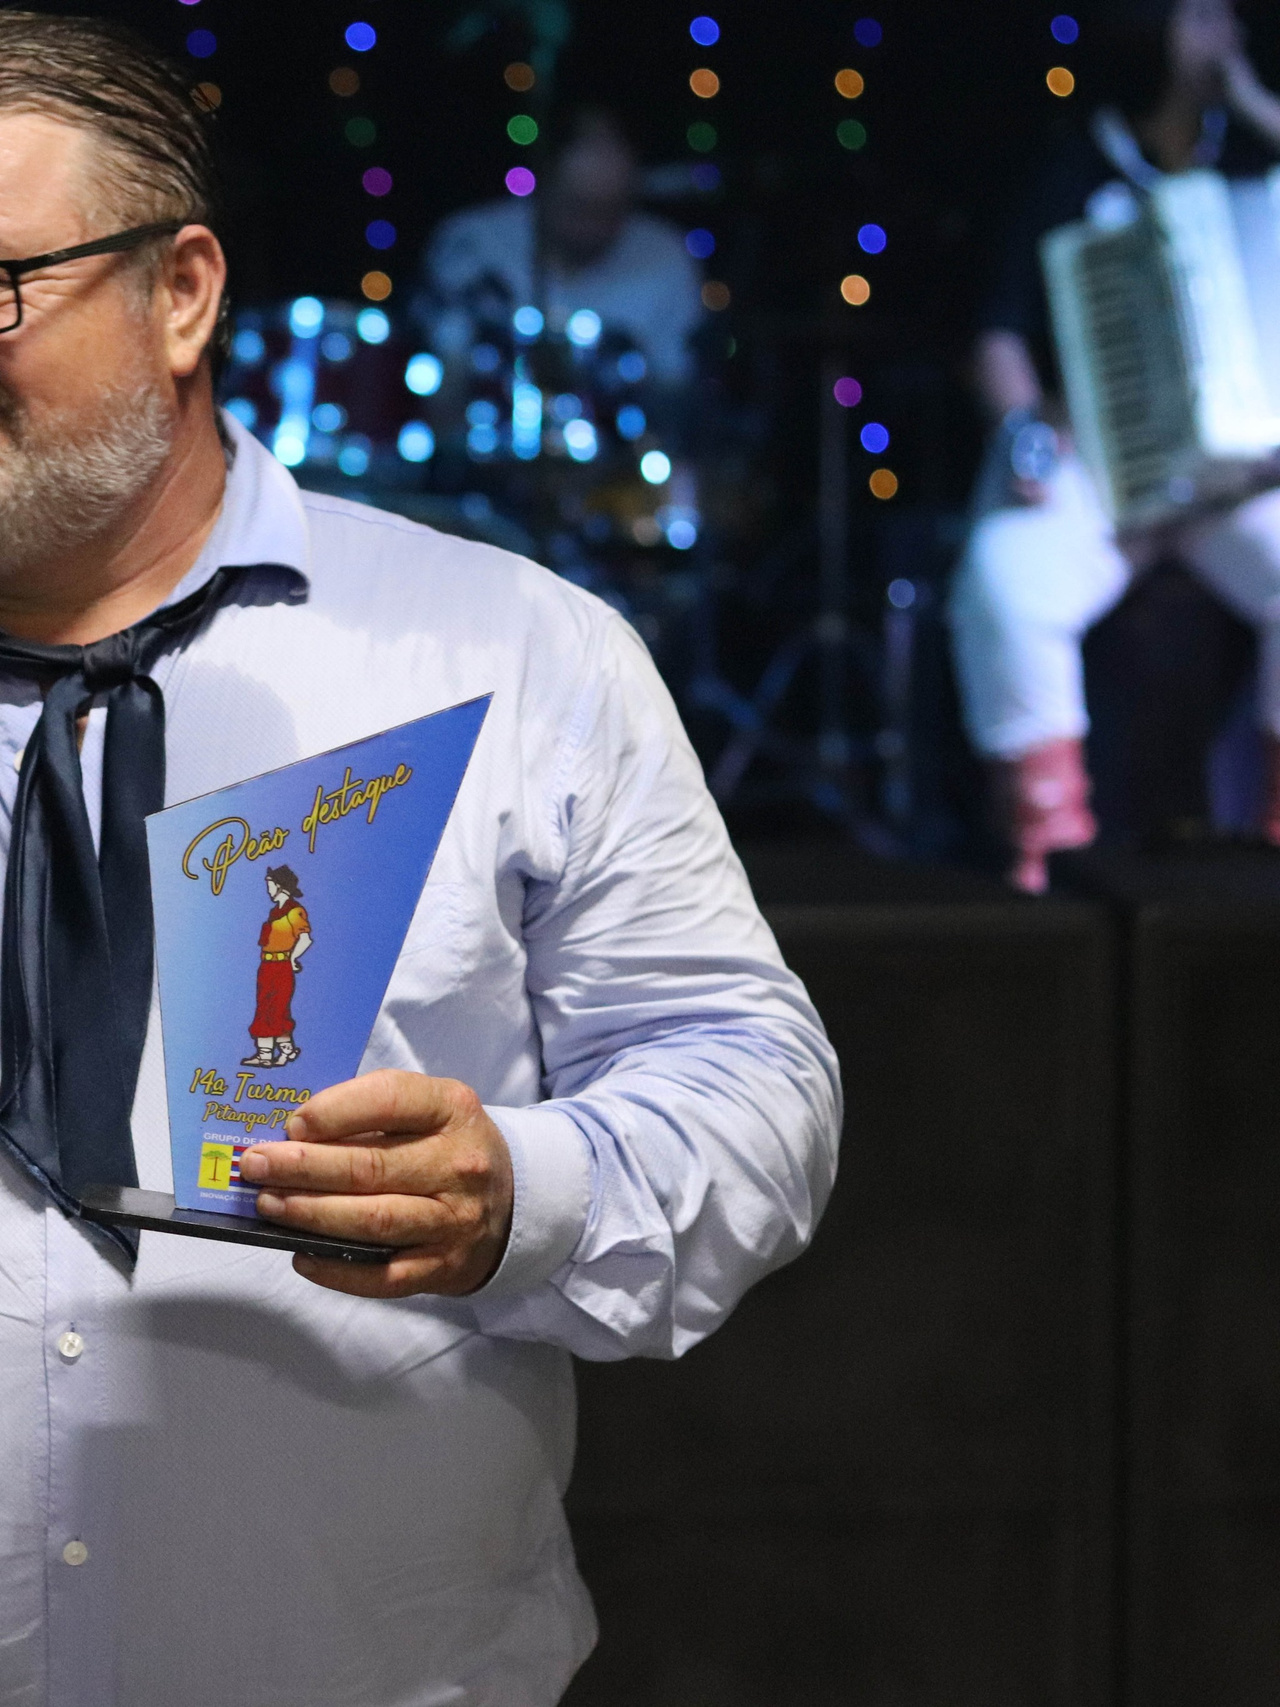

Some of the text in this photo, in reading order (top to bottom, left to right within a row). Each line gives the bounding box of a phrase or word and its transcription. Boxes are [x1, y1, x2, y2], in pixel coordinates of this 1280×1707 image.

[183, 763, 413, 895] Peão destaque
[234, 1072, 311, 1104] Turma
[203, 1132, 240, 1143] GRUPO
[242, 1137, 257, 1145] DE
